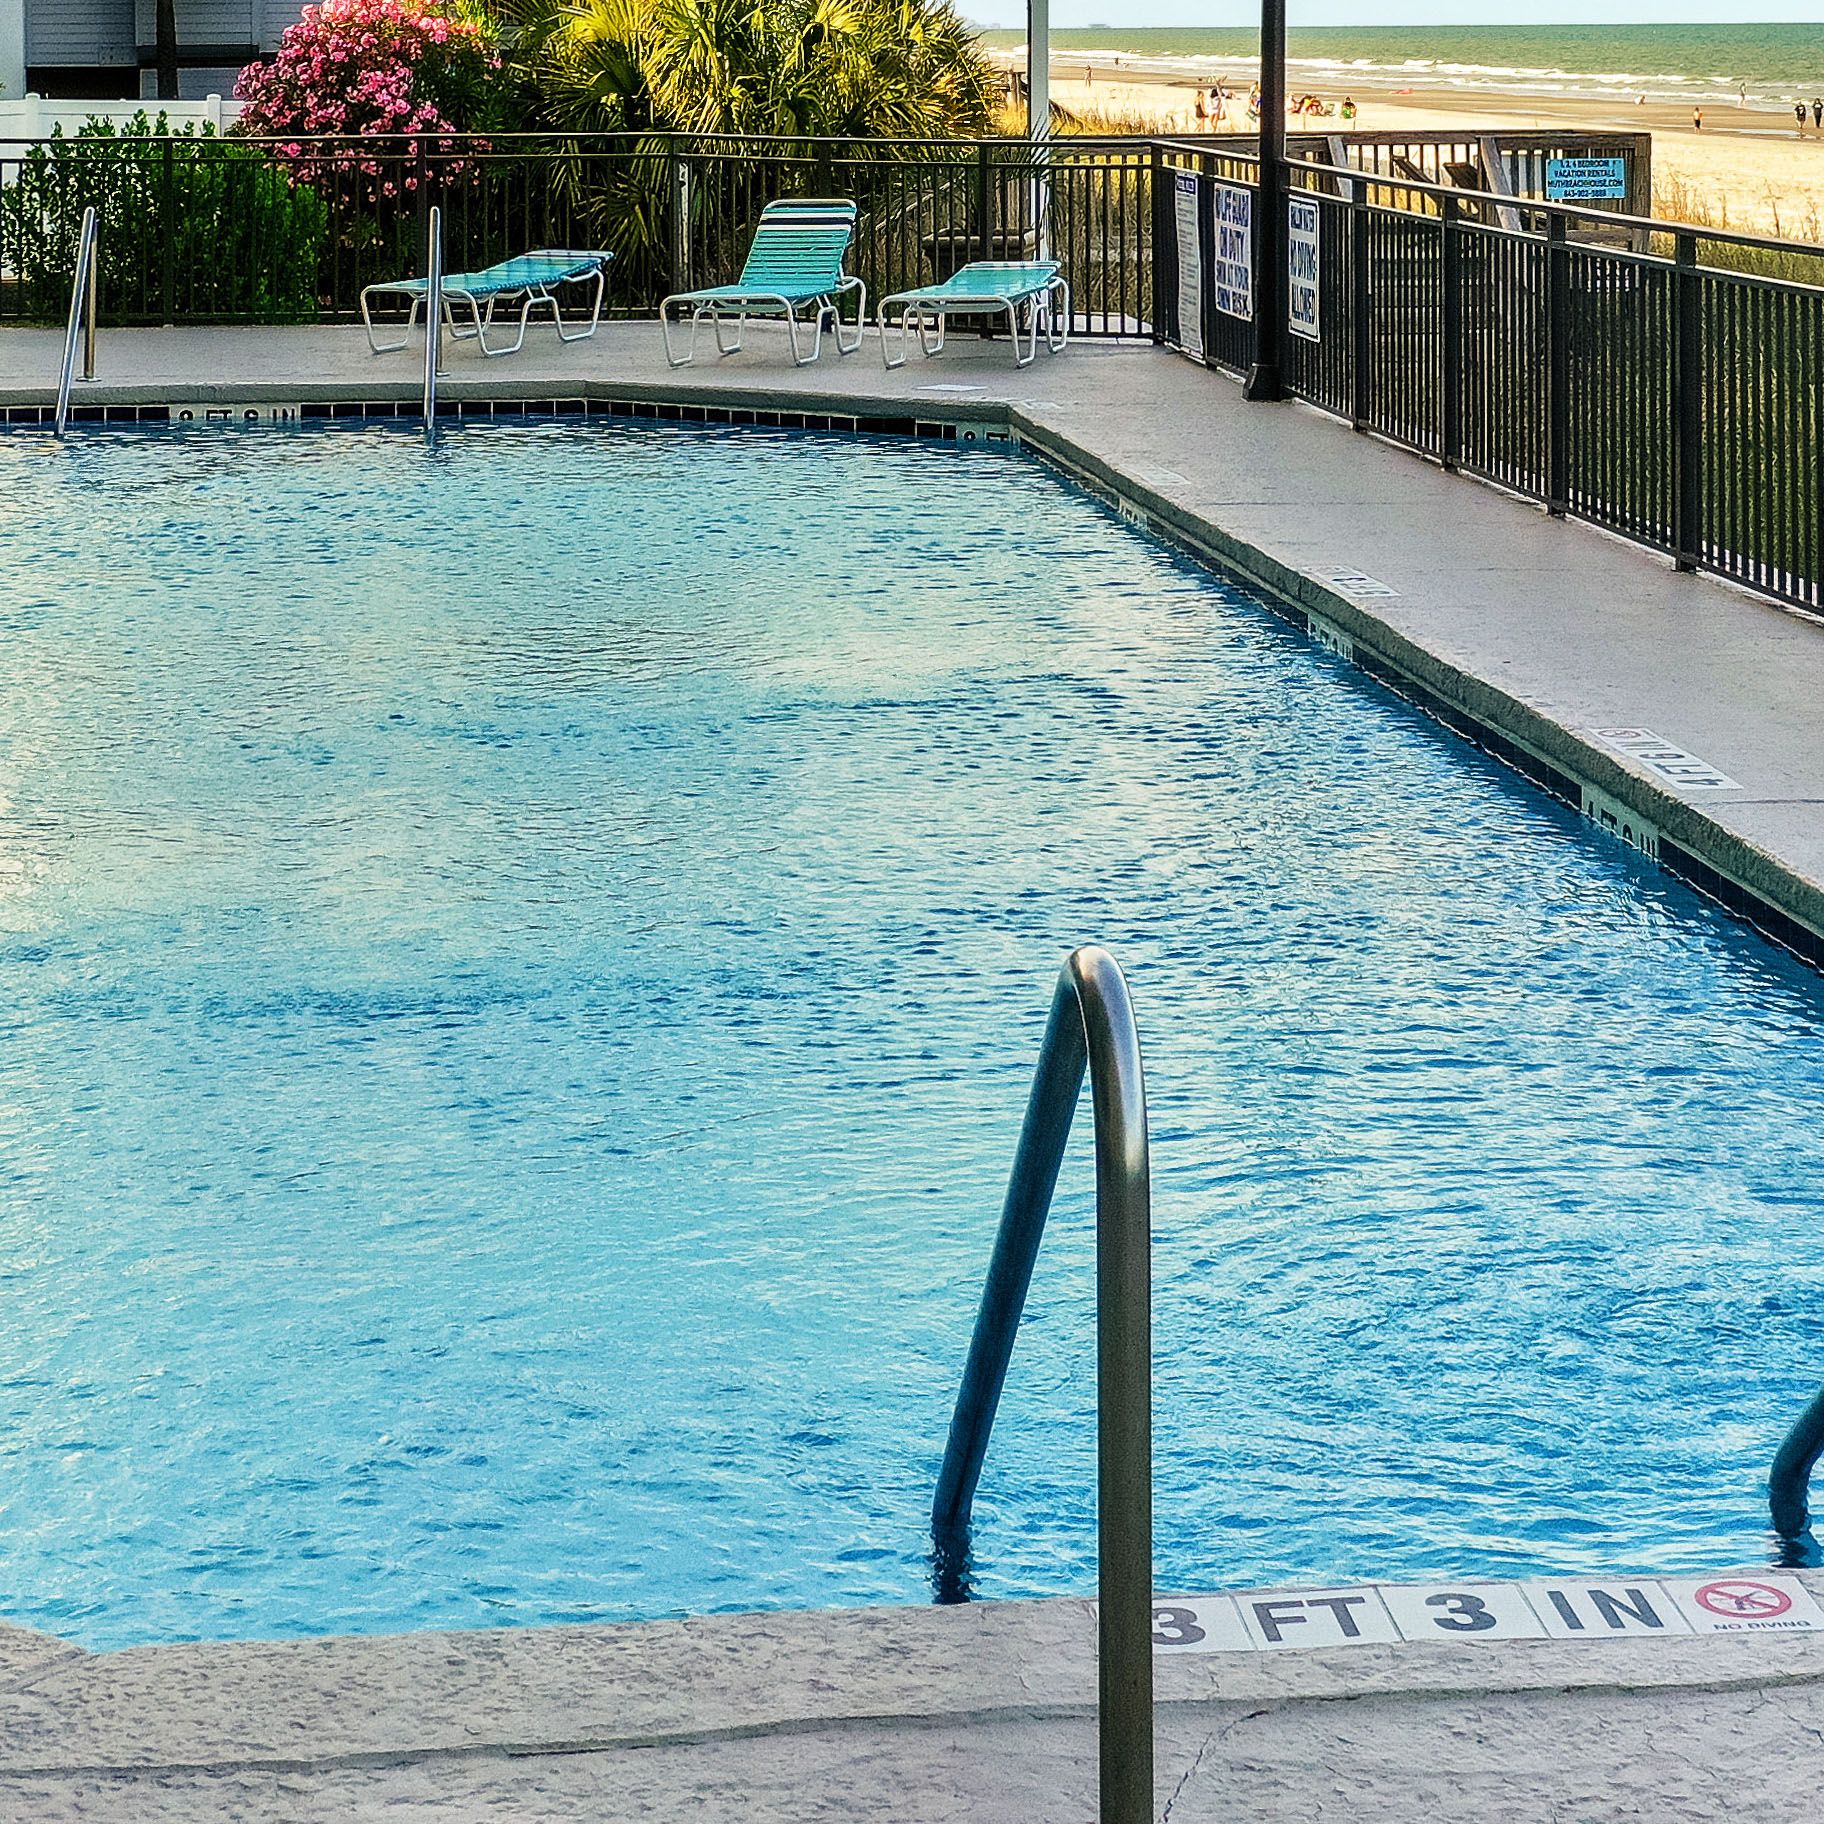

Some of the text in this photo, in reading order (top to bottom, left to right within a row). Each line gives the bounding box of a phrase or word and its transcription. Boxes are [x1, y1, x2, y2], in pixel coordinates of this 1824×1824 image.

[1152, 1588, 1664, 1645] 3 FT 3 IN
[1747, 1620, 1812, 1630] DIVING
